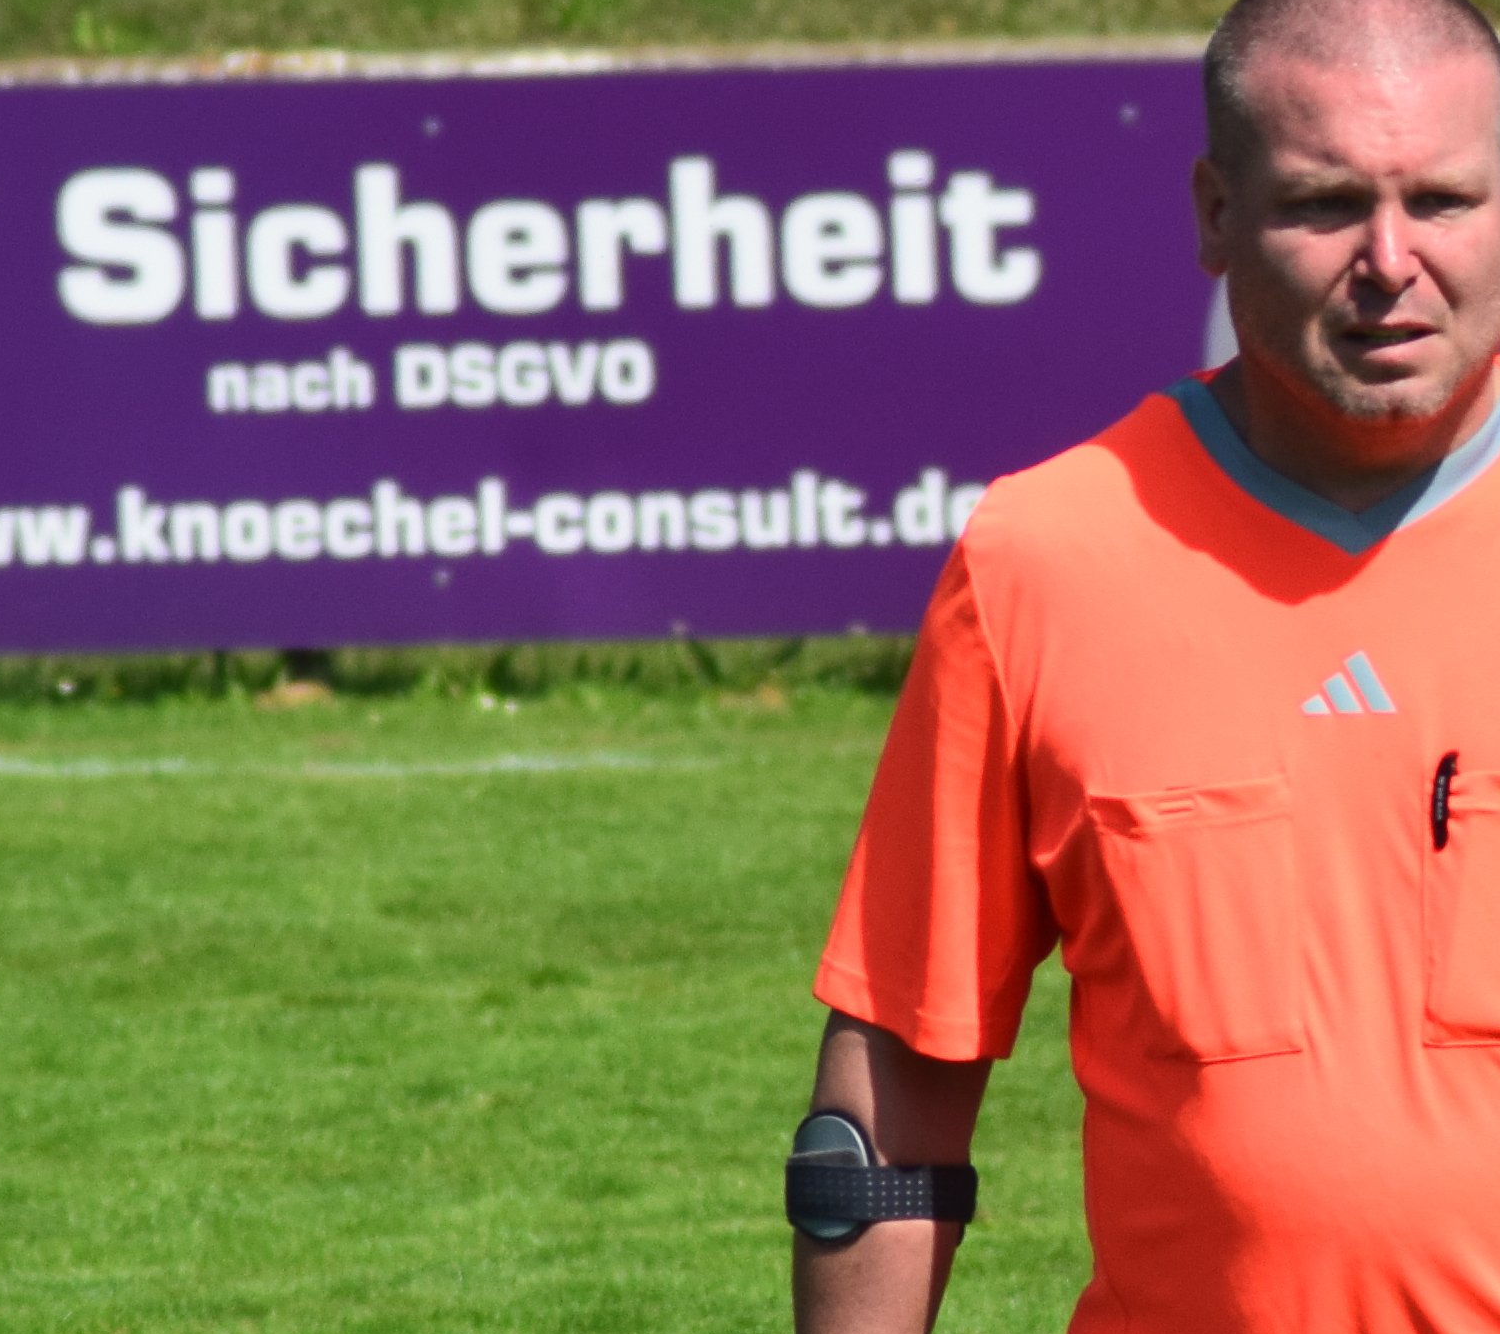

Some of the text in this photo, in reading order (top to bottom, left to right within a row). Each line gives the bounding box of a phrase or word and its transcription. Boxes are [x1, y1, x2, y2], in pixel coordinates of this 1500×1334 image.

[56, 151, 1042, 326] Sicherheit
[207, 338, 655, 413] nach DSGVO
